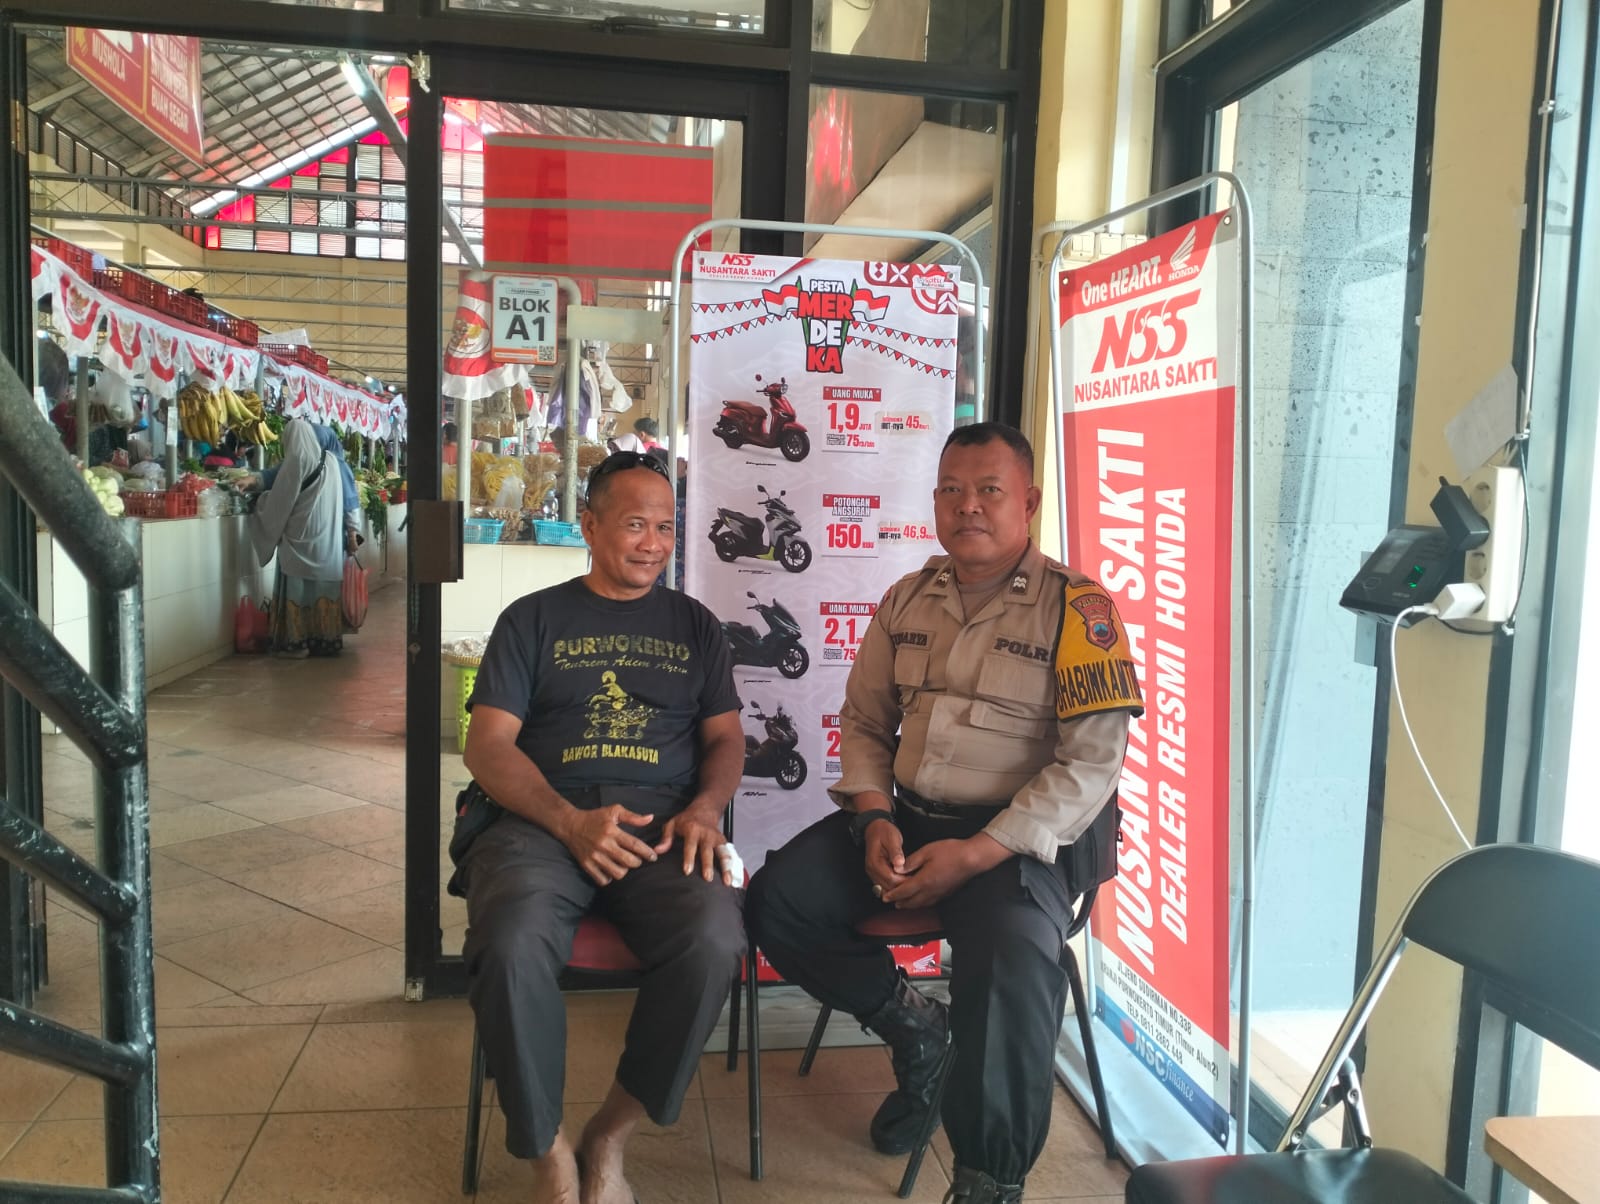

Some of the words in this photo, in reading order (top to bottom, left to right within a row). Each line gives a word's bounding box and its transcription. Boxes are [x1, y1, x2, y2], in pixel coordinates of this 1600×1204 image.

[700, 266, 749, 275] NUSANTARA
[752, 269, 776, 277] SAKTI
[1168, 265, 1200, 282] HONDA
[810, 279, 844, 292] PESTA
[1082, 280, 1107, 306] One
[499, 297, 550, 313] BLOK
[799, 291, 854, 320] MER
[505, 314, 545, 341] A1
[810, 319, 842, 346] DE
[1091, 288, 1201, 374] NSS
[807, 345, 843, 373] KA
[1074, 369, 1160, 403] NUSANTARA
[1165, 356, 1218, 388] SAKTI
[832, 388, 851, 398] UANG
[853, 389, 874, 399] MUKA
[827, 403, 860, 433] 1,9
[905, 415, 920, 429] 45
[846, 434, 860, 447] 75
[832, 506, 871, 517] ANGSURAN
[833, 497, 871, 507] POTONGAN
[1097, 428, 1146, 601] SAKTI
[826, 523, 861, 549] 150
[1155, 488, 1186, 631] HONDA
[829, 604, 847, 613] UANG
[850, 604, 870, 614] MUKA
[824, 618, 856, 647] 2,1
[553, 634, 691, 661] PURWOKERTO
[612, 654, 650, 668] Adem
[994, 637, 1052, 663] POLR
[1156, 638, 1186, 776] RESMI
[562, 744, 598, 763] BAWOR
[602, 743, 659, 764] BLAKASUTA
[1158, 784, 1187, 945] DEALER
[1118, 977, 1153, 1018] PURWOKERTO
[1154, 1010, 1174, 1037] TIMUR
[1138, 978, 1168, 1014] SUDIRMAN
[1169, 1005, 1192, 1036] NO.338
[1135, 1029, 1165, 1077] NSC
